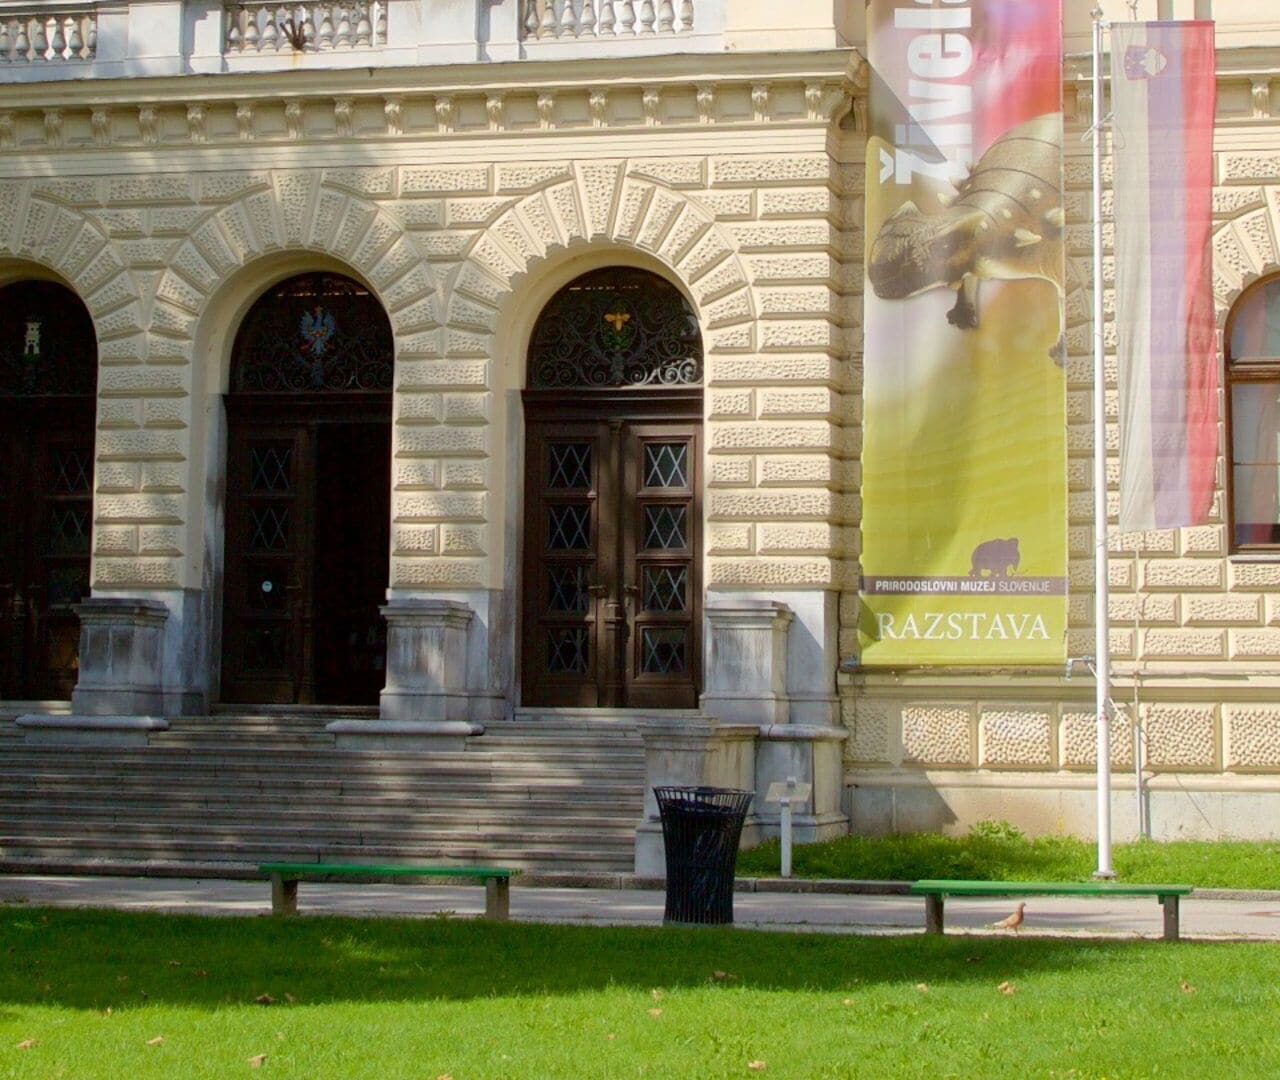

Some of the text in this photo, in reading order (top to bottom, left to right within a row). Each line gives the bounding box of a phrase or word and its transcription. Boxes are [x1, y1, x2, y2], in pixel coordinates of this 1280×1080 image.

[875, 580, 1050, 592] PRIRODOSLOVNI MUZEJ SLOVENIJE
[876, 612, 1051, 640] RAZSTAVA
